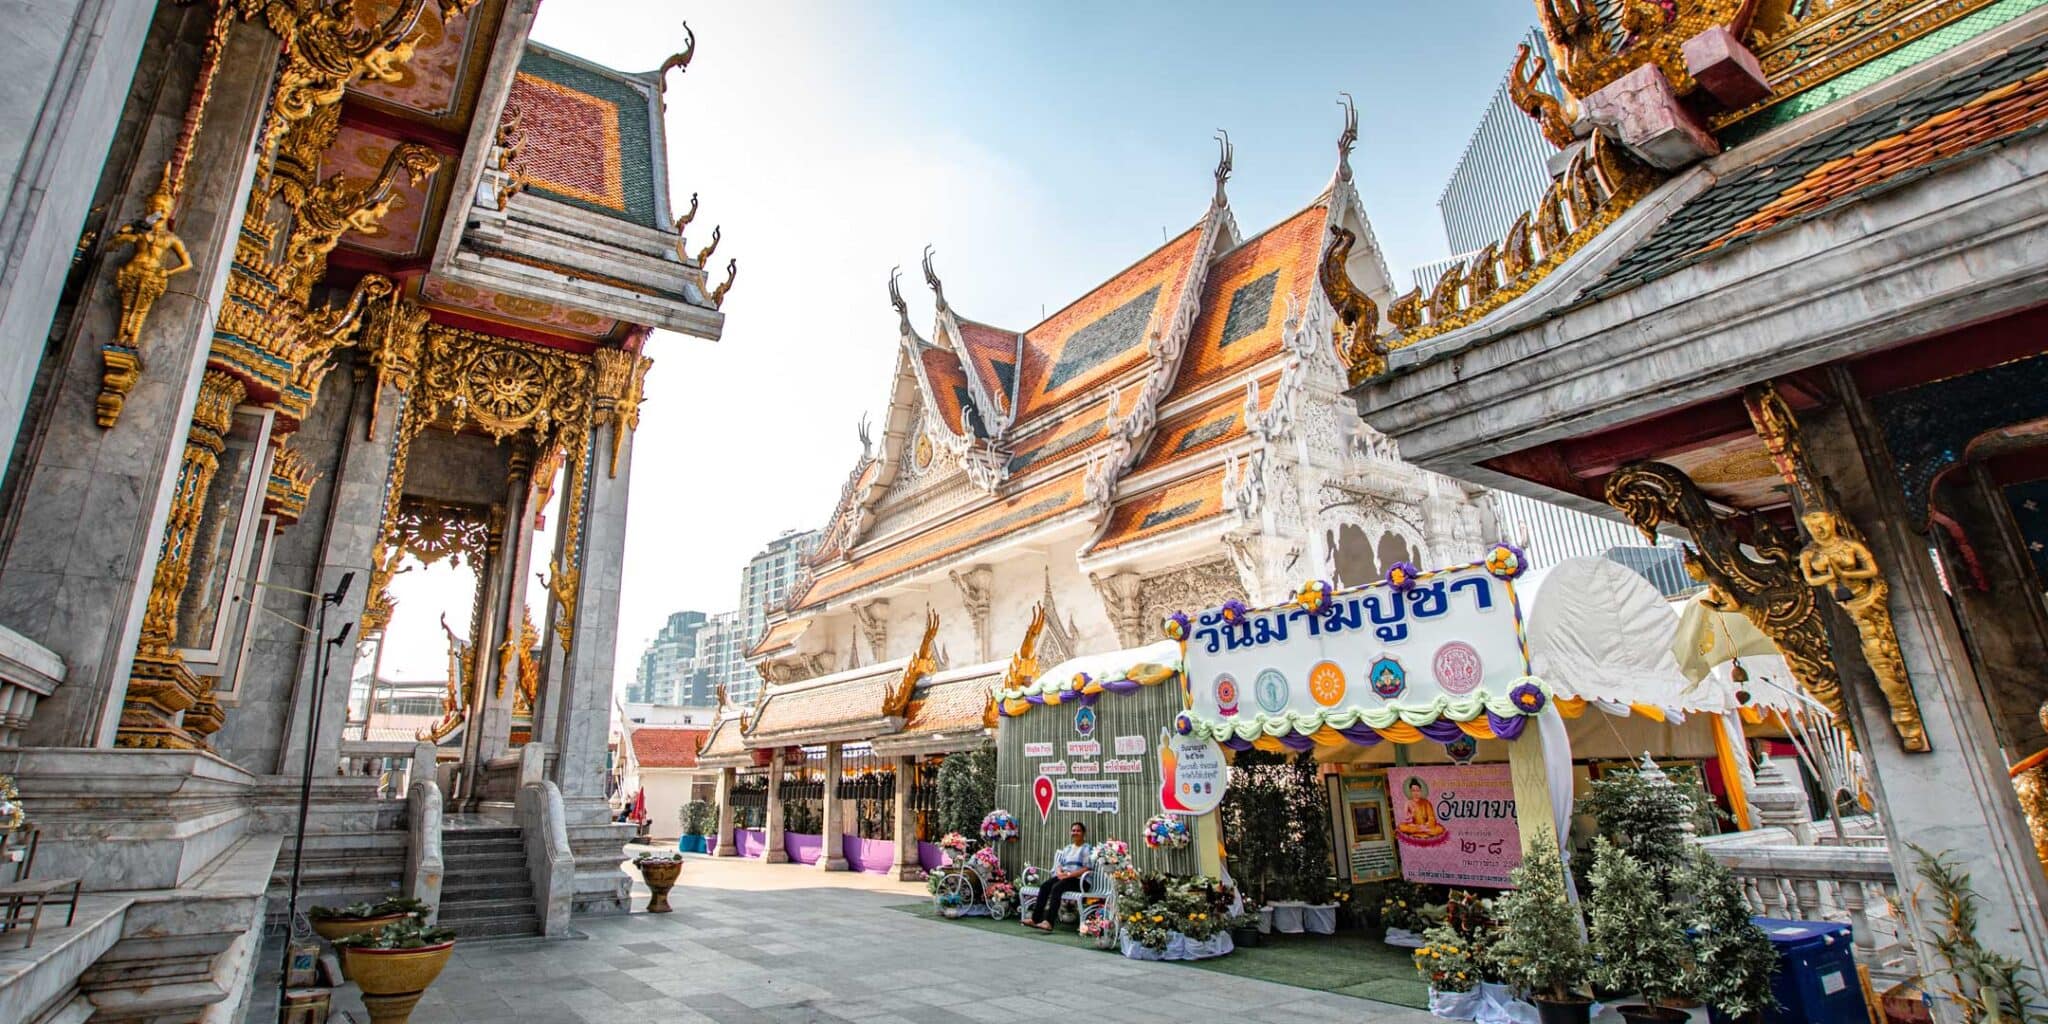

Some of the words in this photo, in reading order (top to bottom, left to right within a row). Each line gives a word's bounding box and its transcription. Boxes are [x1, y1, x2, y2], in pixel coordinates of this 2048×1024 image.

[1195, 577, 1492, 653] วันมาฆบูชา
[1059, 799, 1070, 808] Wat
[1071, 799, 1083, 809] Hua
